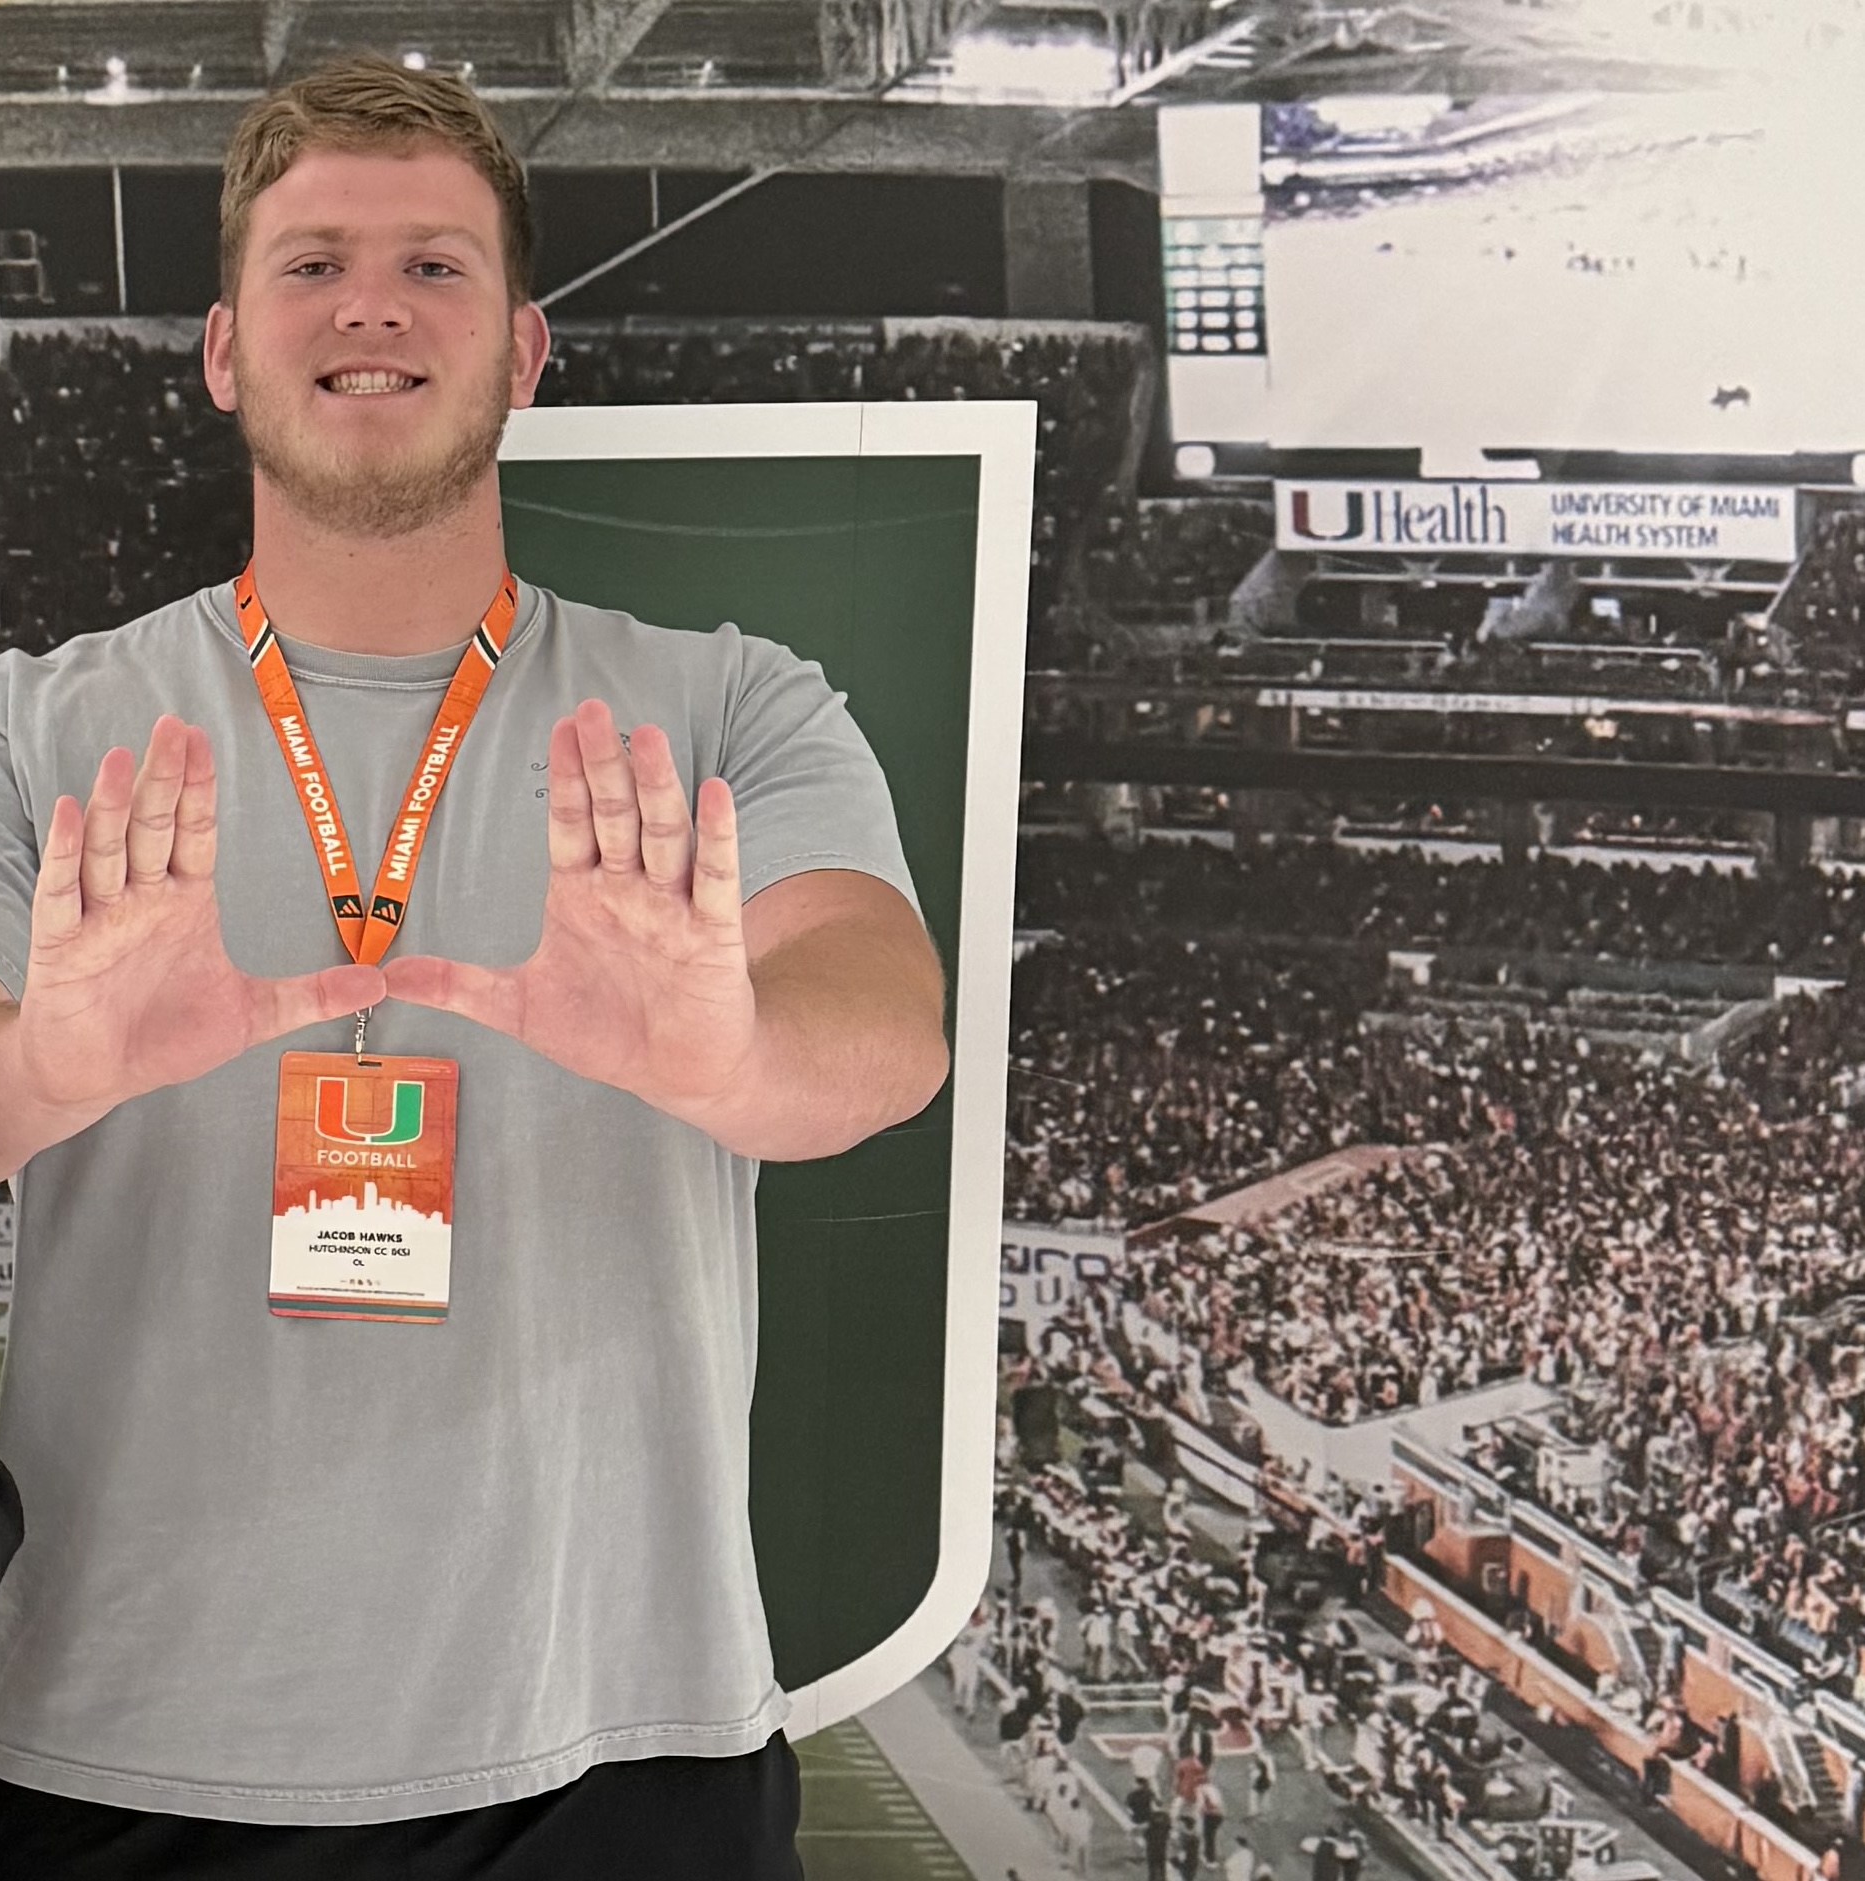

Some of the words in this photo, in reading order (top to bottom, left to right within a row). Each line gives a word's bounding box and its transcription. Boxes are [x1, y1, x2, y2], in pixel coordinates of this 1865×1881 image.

[1551, 493, 1671, 517] UNIVERSITY
[1678, 496, 1704, 517] OF
[1710, 496, 1780, 519] MIAMI
[1552, 523, 1630, 546] HEALTH
[1636, 525, 1718, 548] SYSTEM
[279, 715, 315, 768] MIAMI
[300, 771, 348, 877] FOOTBALL
[386, 817, 422, 881] MIAMI
[407, 724, 461, 812] FOOTBALL
[314, 1076, 426, 1146] U
[316, 1150, 418, 1169] FOOTBALL
[317, 1230, 356, 1241] JACOB
[359, 1231, 403, 1243] HAWKS
[308, 1244, 372, 1255] HUTCHINSON
[373, 1246, 388, 1256] CC
